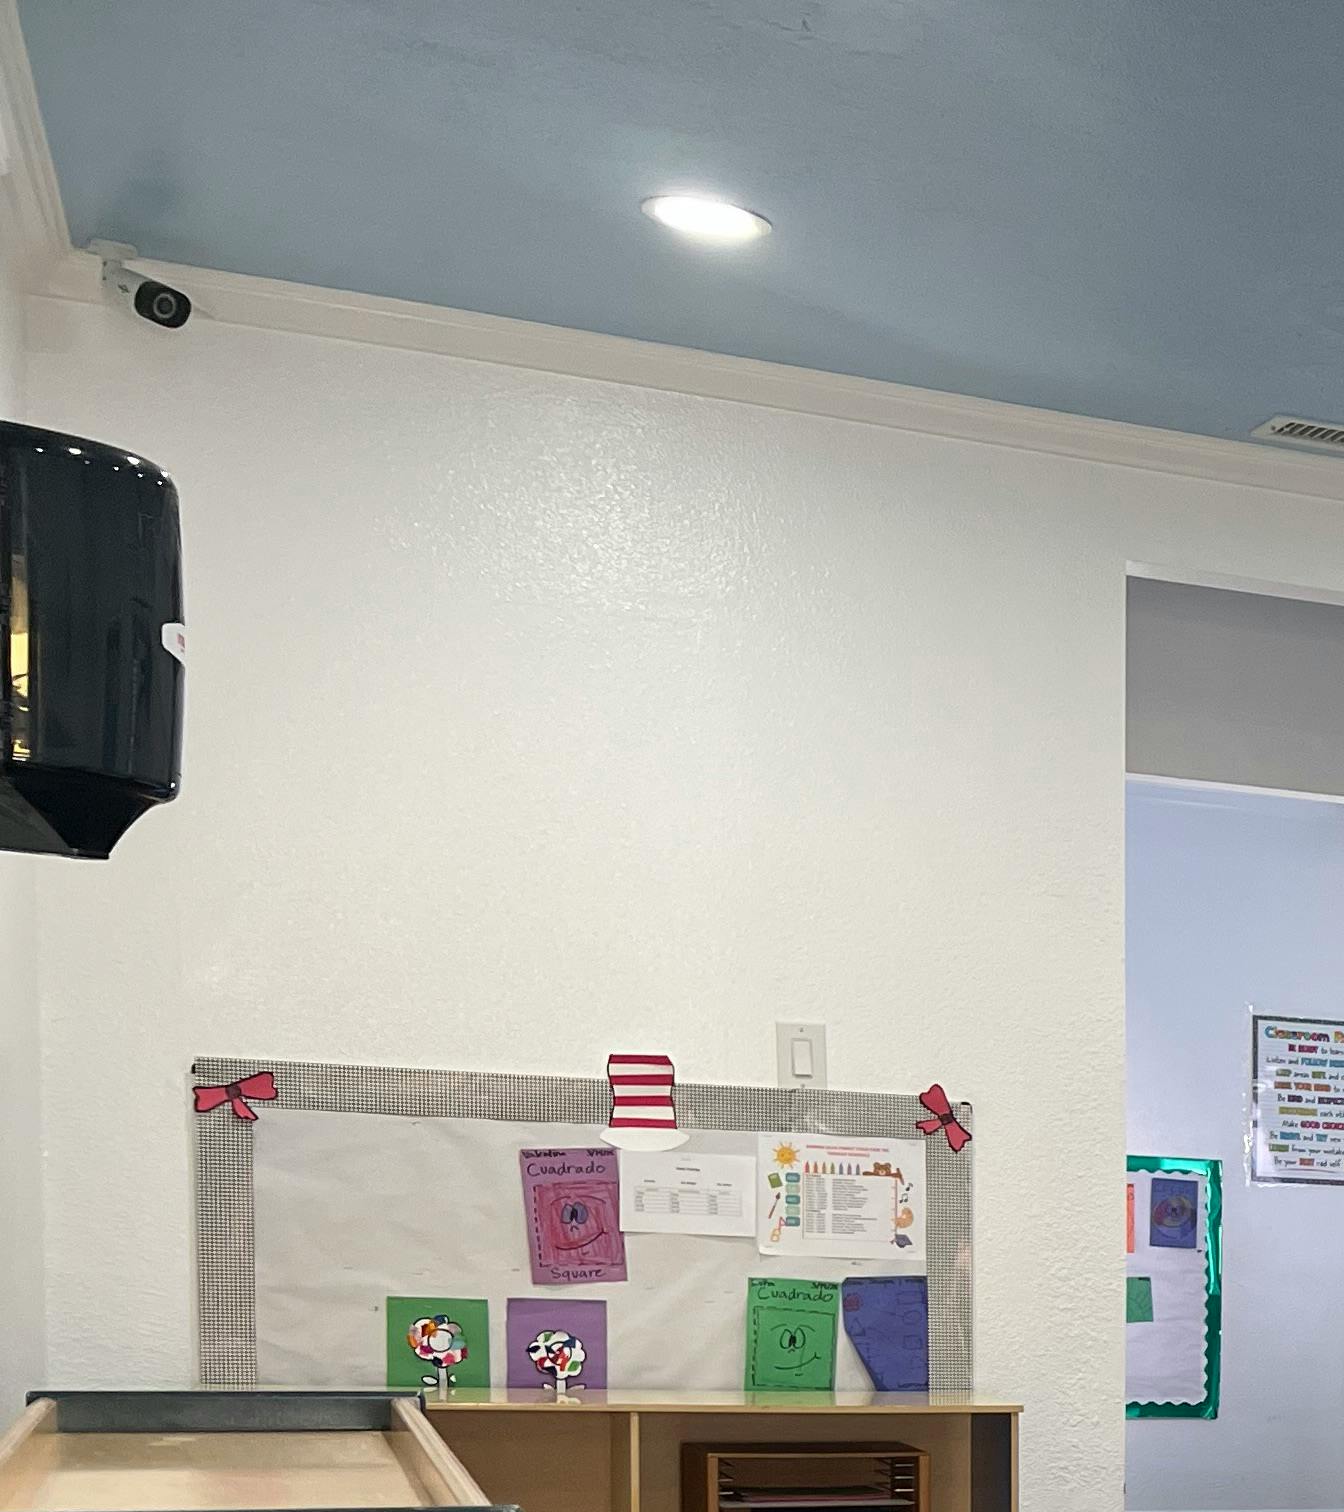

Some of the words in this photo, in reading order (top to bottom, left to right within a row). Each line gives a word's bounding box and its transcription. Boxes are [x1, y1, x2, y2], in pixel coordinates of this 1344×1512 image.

[1264, 1025, 1330, 1043] Classroom
[526, 1160, 606, 1177] Cuadrado
[550, 1267, 607, 1281] Square
[757, 1287, 834, 1303] Cuadrado
